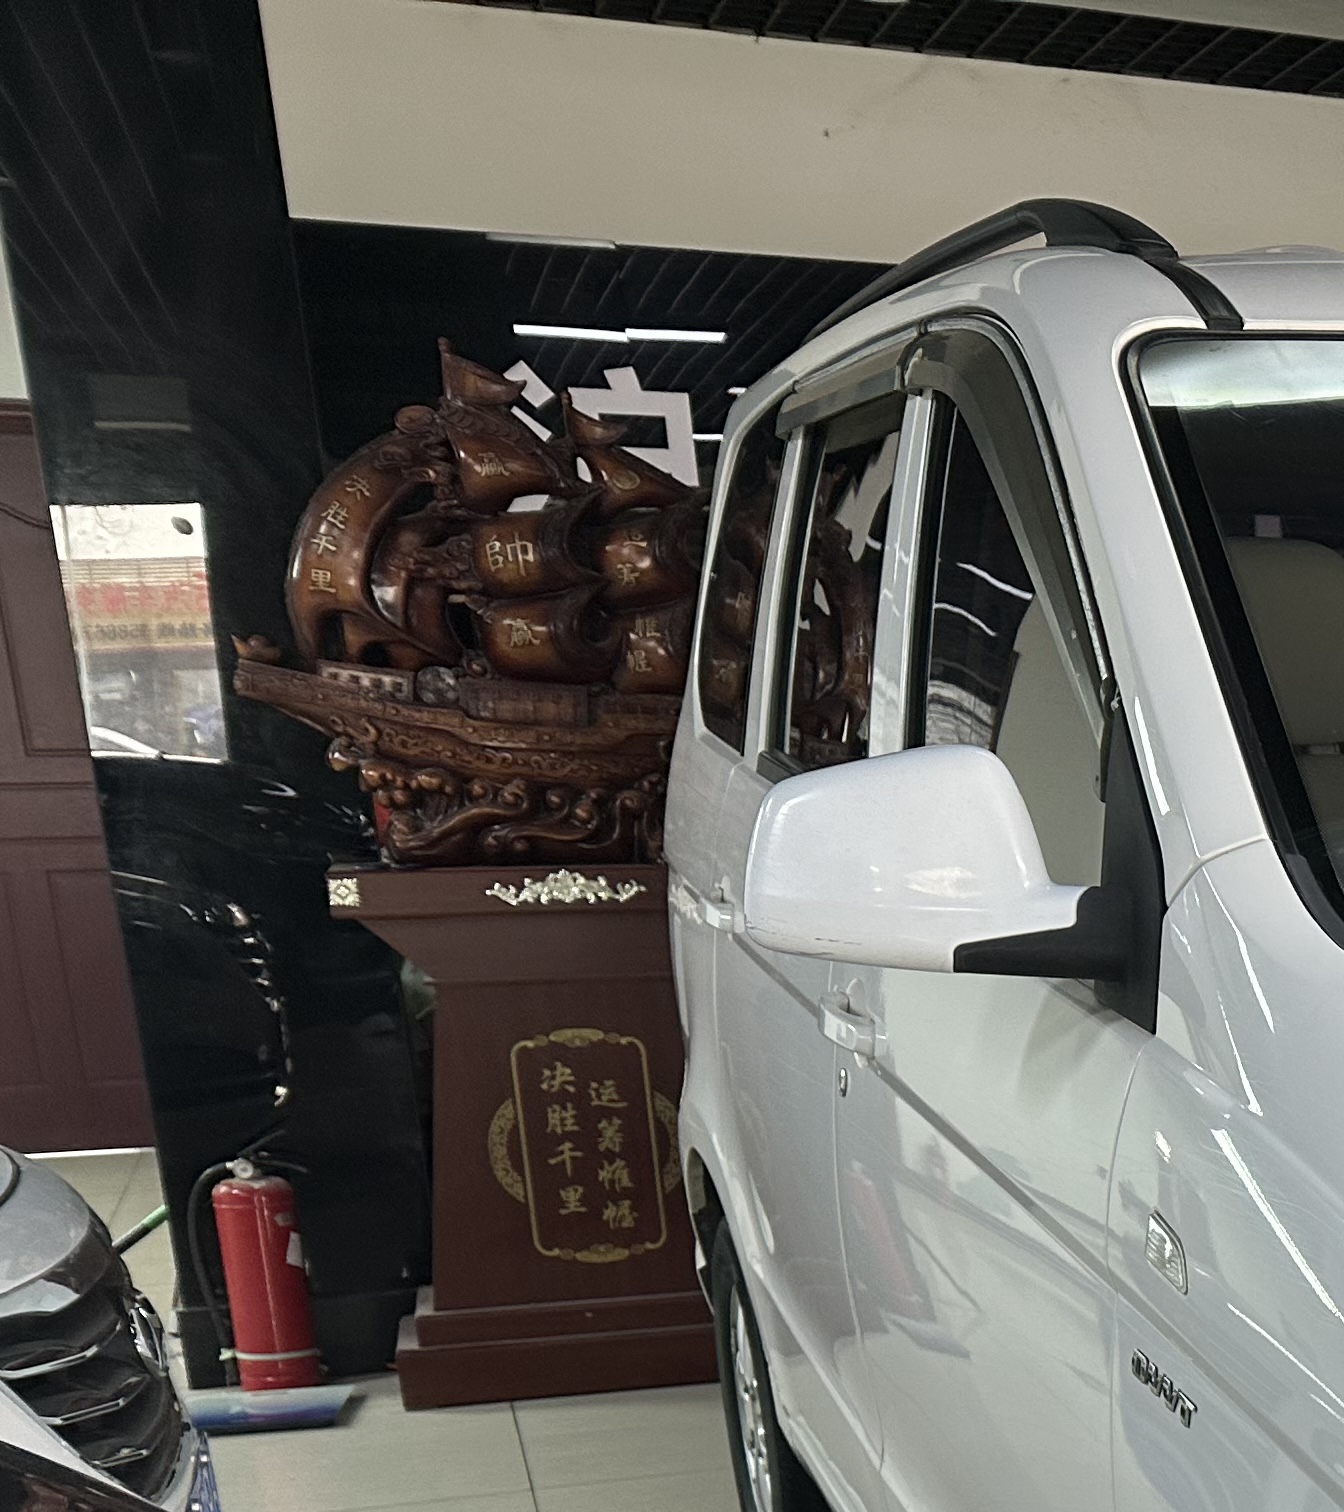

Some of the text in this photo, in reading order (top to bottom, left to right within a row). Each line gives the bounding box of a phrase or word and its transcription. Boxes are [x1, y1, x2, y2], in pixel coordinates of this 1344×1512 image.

[539, 1061, 588, 1216] 决胜千里
[589, 1079, 639, 1231] 运筹帷幄
